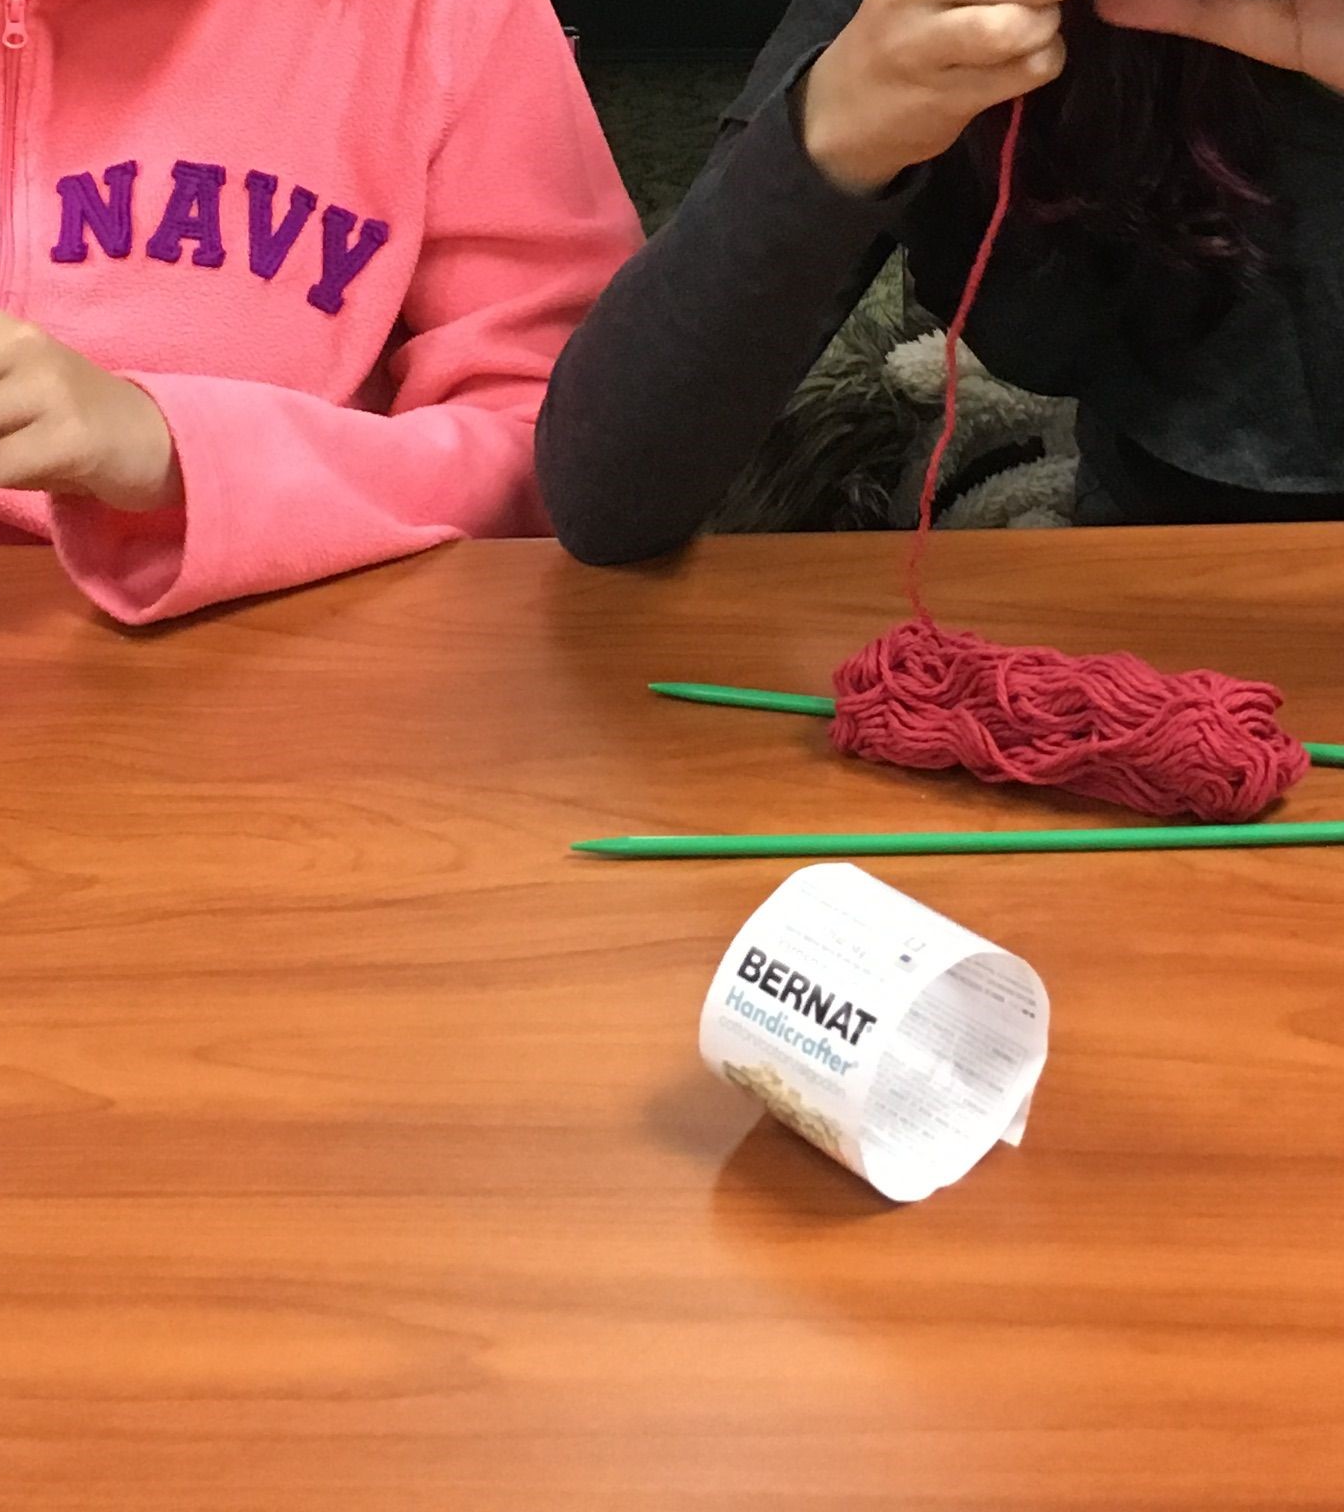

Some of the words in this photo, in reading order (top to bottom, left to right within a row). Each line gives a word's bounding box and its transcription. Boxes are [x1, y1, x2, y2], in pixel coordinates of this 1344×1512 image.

[50, 158, 388, 315] NAVY
[725, 984, 859, 1076] Handicrafter
[736, 946, 878, 1046] BERNAT
